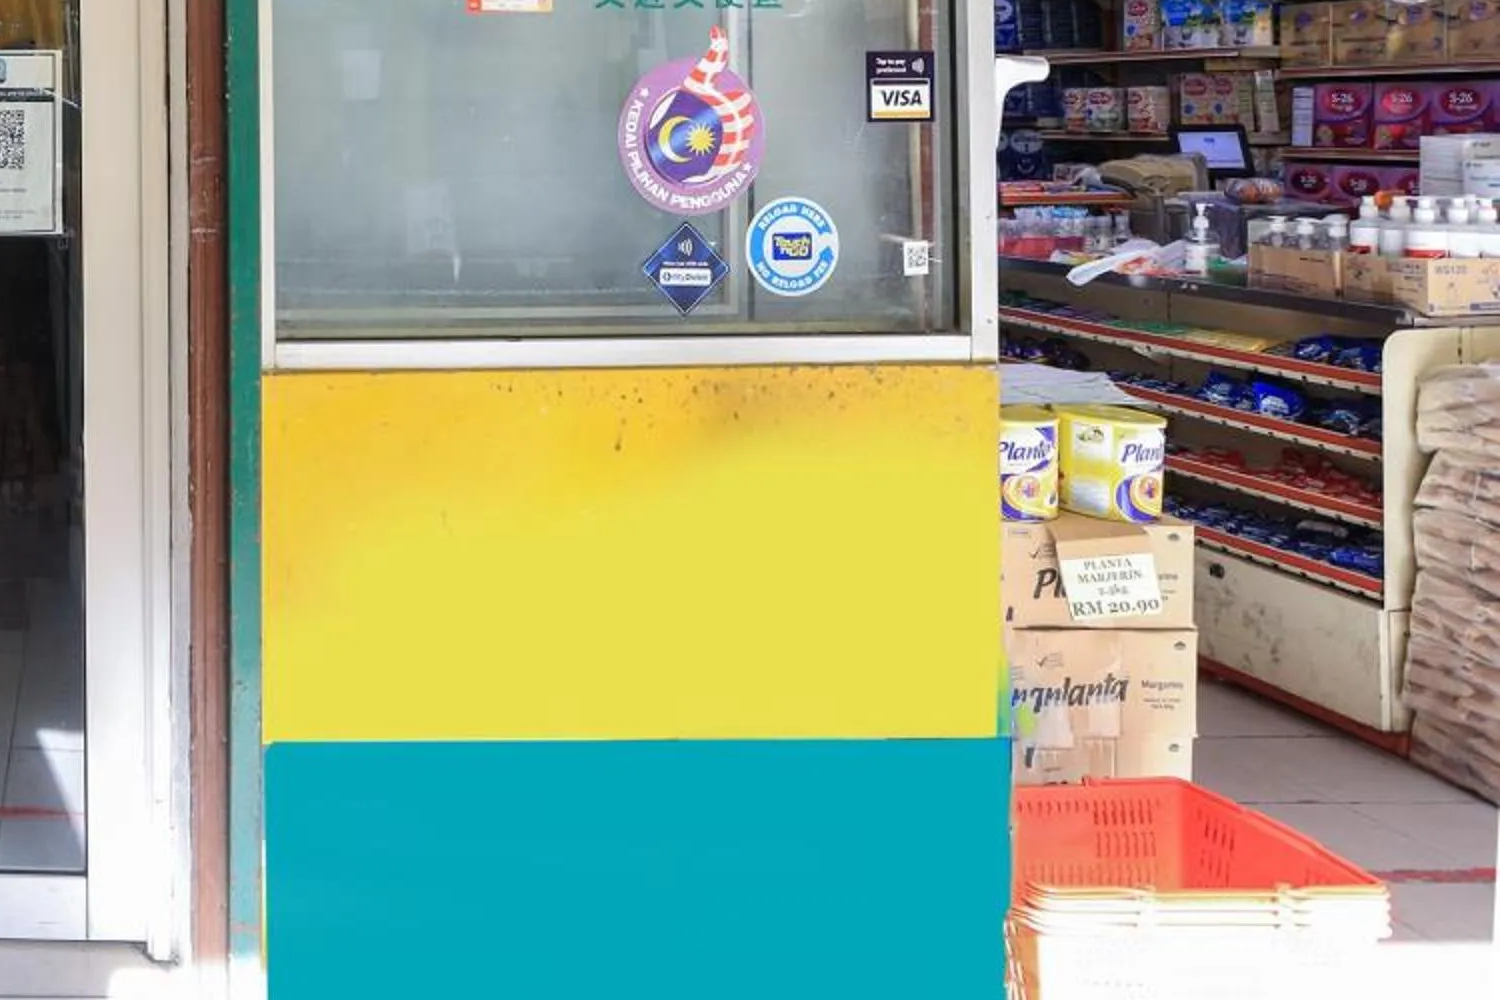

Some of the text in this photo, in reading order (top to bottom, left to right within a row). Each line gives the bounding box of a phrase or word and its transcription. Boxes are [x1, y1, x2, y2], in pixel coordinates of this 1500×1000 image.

[881, 89, 923, 106] VISA
[625, 99, 747, 209] KEDAI PILIHAN PENGGUNA
[1083, 557, 1133, 571] PLANTA
[1072, 599, 1160, 617] RM 20.90
